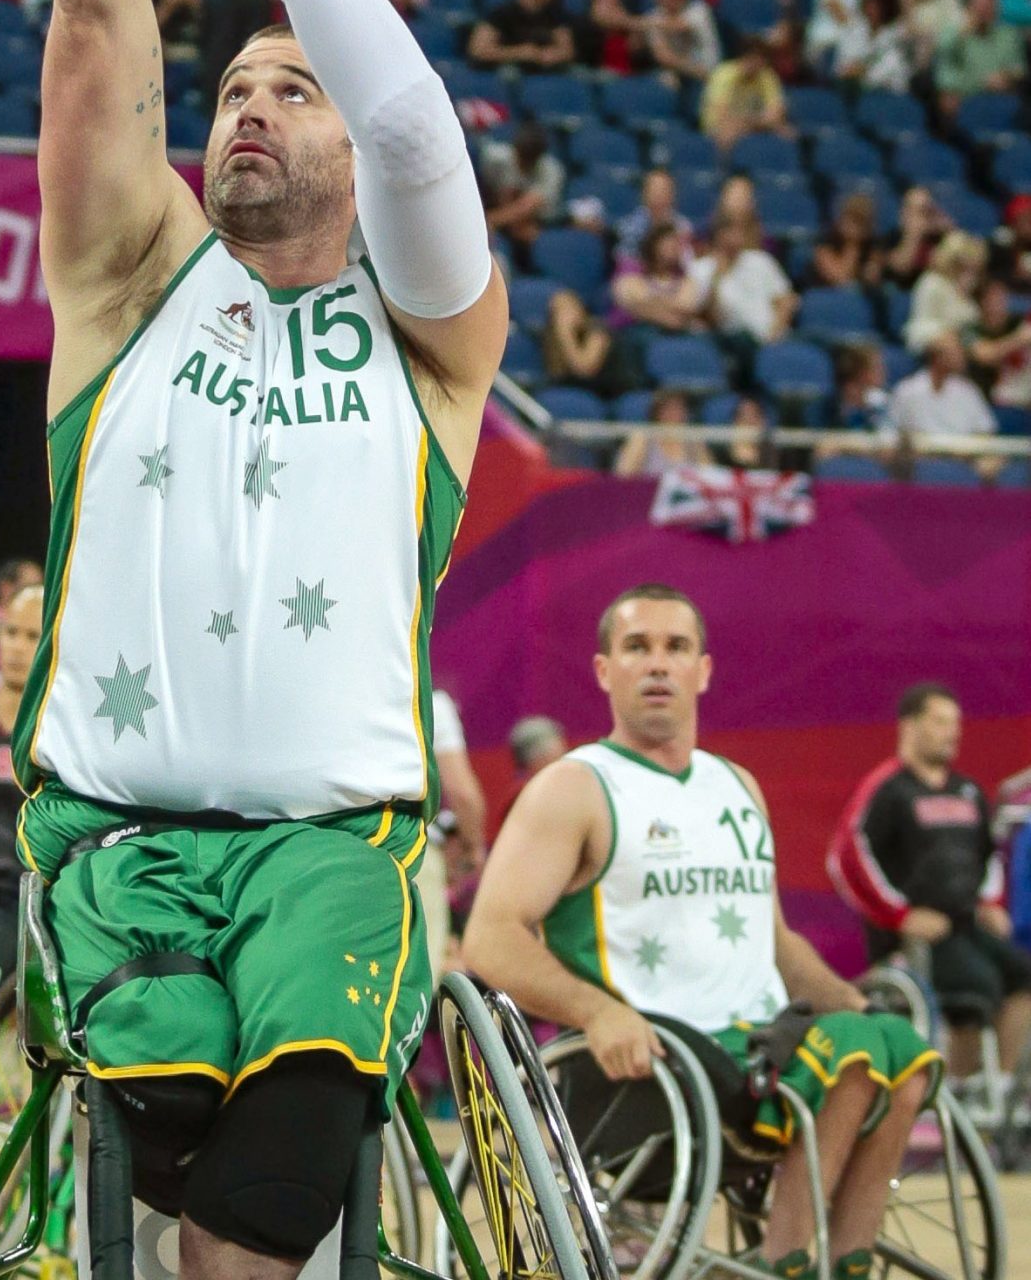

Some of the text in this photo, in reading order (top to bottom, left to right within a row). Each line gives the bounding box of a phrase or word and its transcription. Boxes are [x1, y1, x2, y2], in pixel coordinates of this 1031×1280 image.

[287, 284, 373, 380] 15
[172, 350, 370, 426] AUSALIA
[718, 806, 775, 862] 12
[642, 866, 771, 898] AUSTRALI
